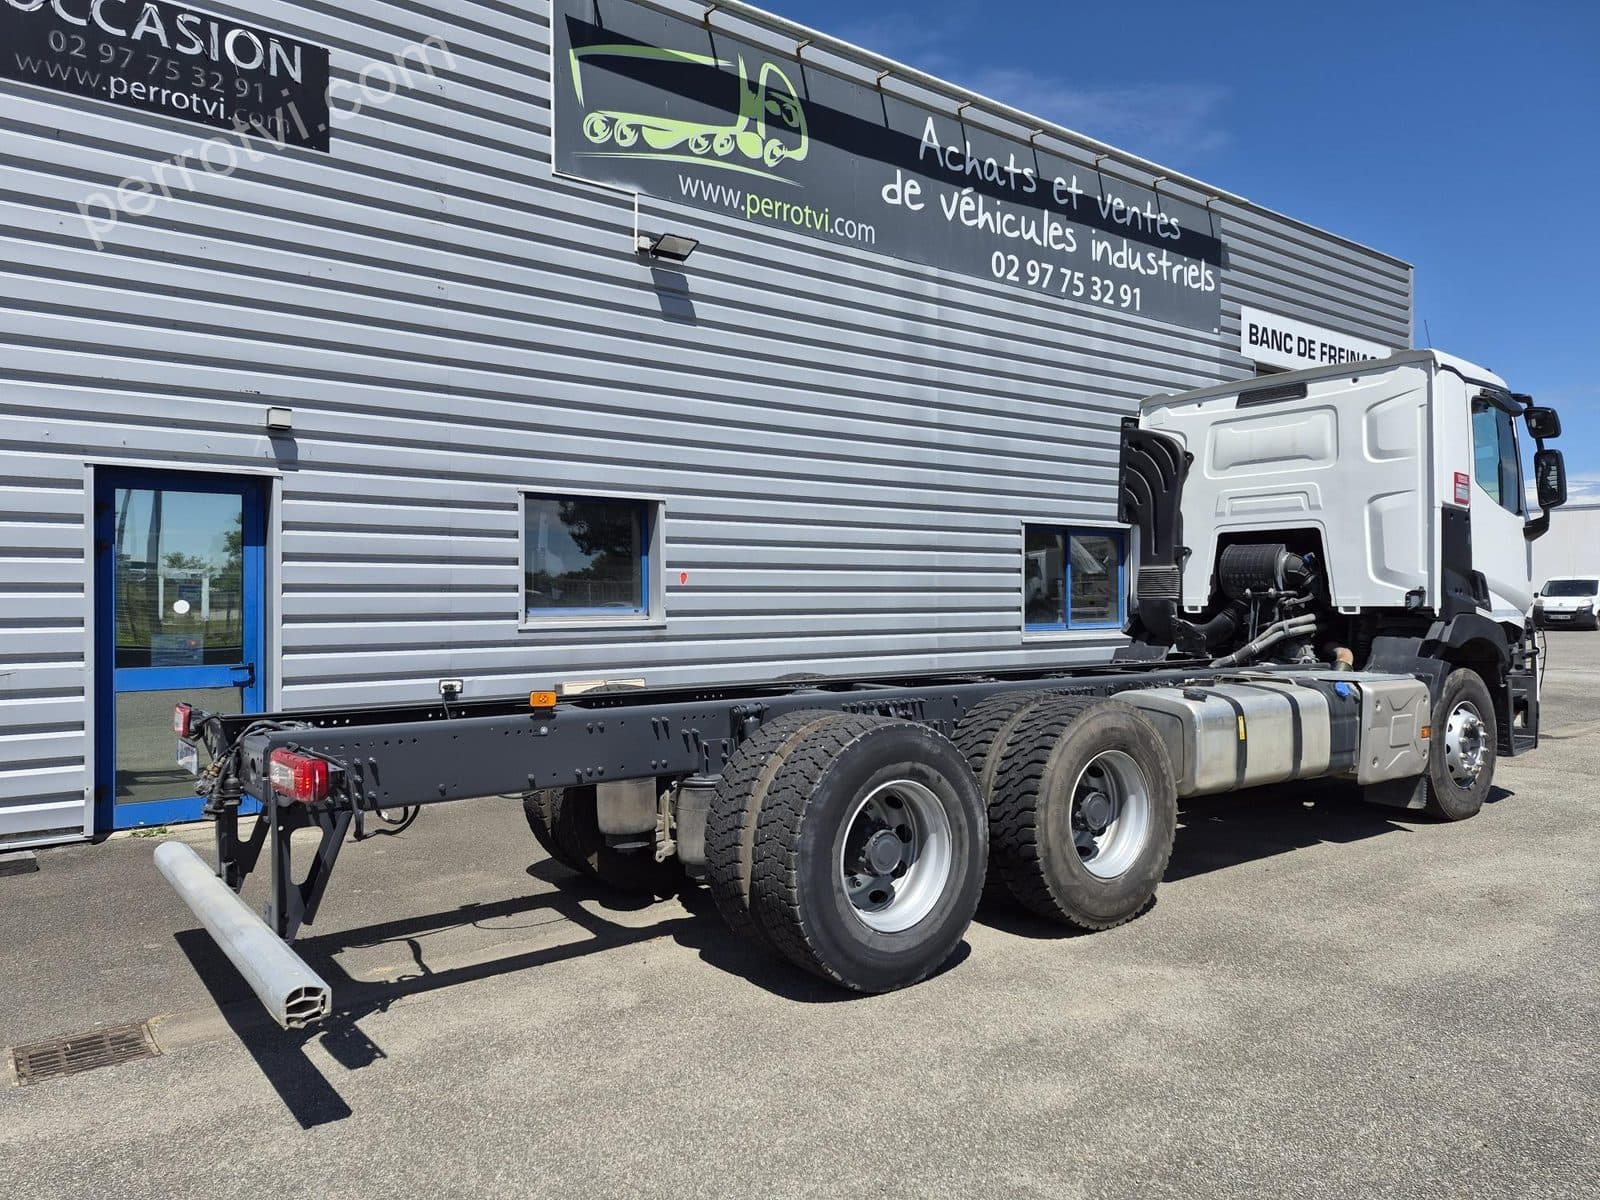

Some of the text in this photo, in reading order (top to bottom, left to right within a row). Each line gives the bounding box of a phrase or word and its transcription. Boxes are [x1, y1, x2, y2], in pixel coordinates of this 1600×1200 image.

[15, 52, 290, 134] www.perrotvi.com
[49, 30, 263, 103] 02 97 75 32 91
[678, 174, 876, 244] www.perrotvi.com
[919, 116, 1182, 240] Achats et ventes
[882, 169, 1216, 293] de véhicules industriels
[991, 251, 1141, 311] 02 97 75 32 91
[1249, 323, 1293, 354] BANC
[1297, 336, 1316, 360] DE
